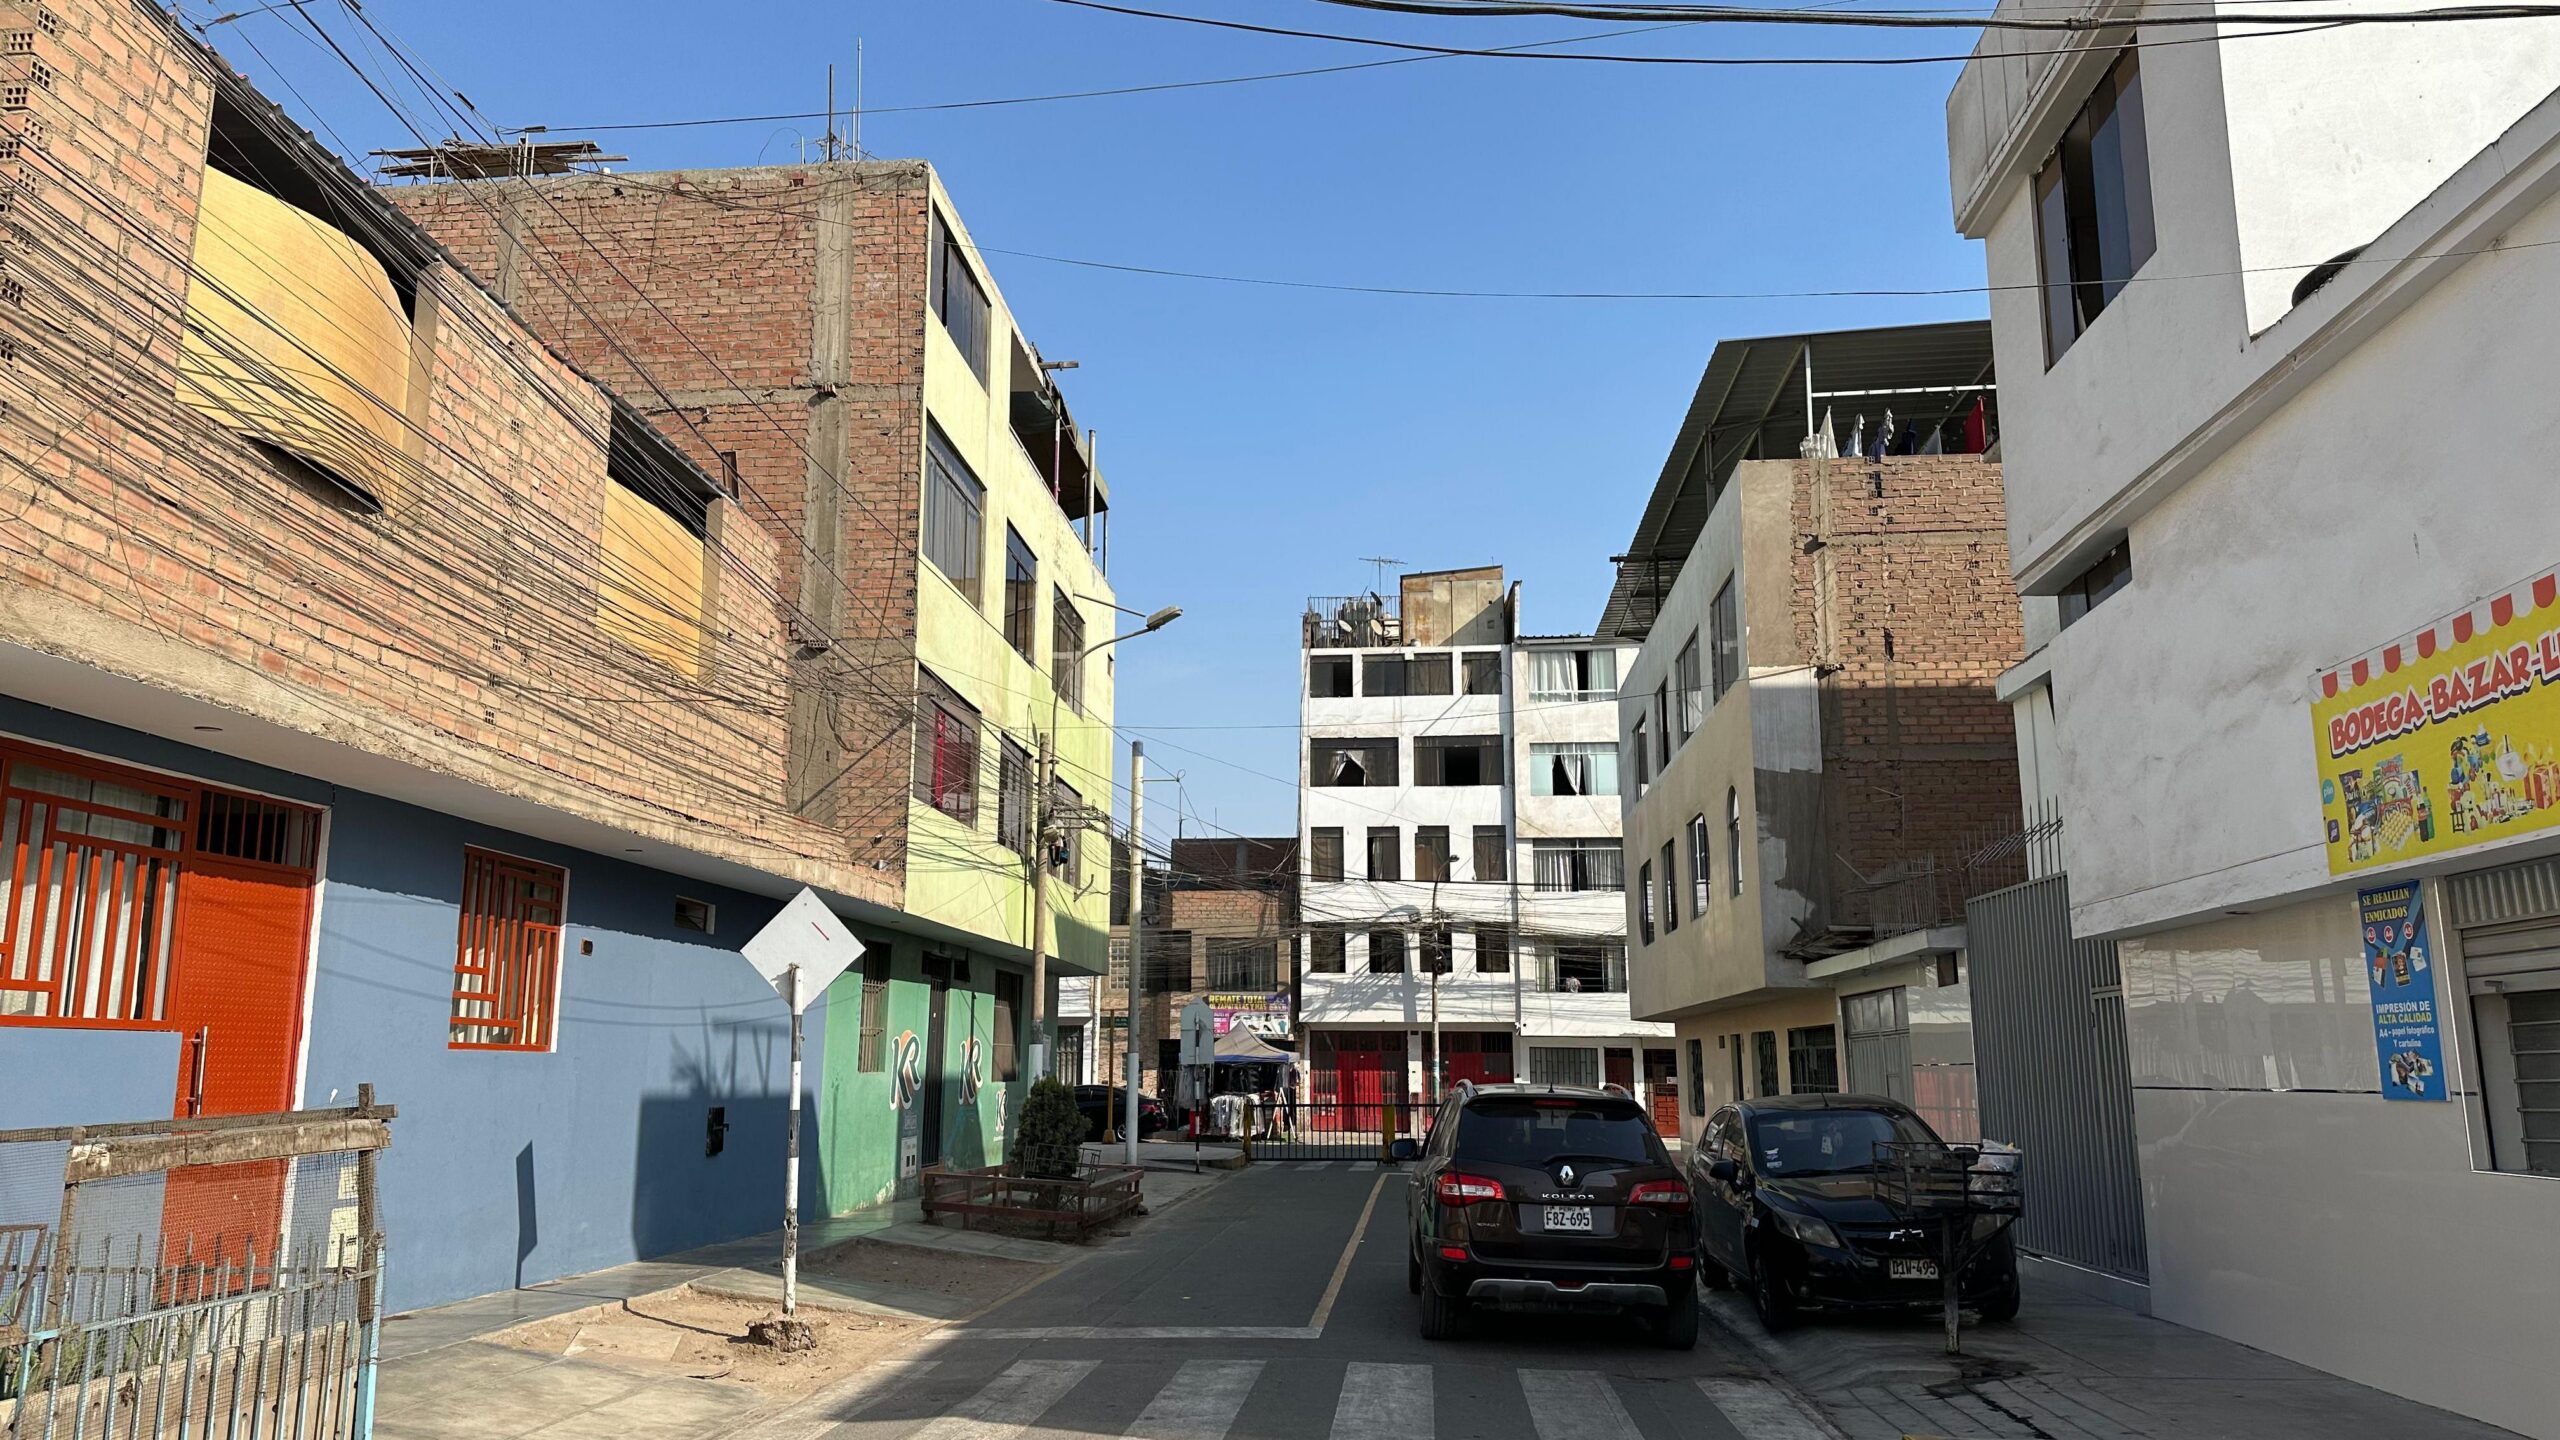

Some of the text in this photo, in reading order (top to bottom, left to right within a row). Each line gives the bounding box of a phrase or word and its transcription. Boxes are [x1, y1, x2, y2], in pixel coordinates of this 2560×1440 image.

[2362, 887, 2410, 906] SE REALIZAN
[2364, 905, 2408, 923] ENMICADOS
[1209, 994, 1266, 1004] REMATE TOTAL
[2376, 1000, 2431, 1014] IMPRESIÓN DE
[2379, 1012, 2432, 1025] ALTA CALIDAD
[2379, 1029, 2388, 1038] A4
[1545, 1211, 1590, 1226] F8Z-695
